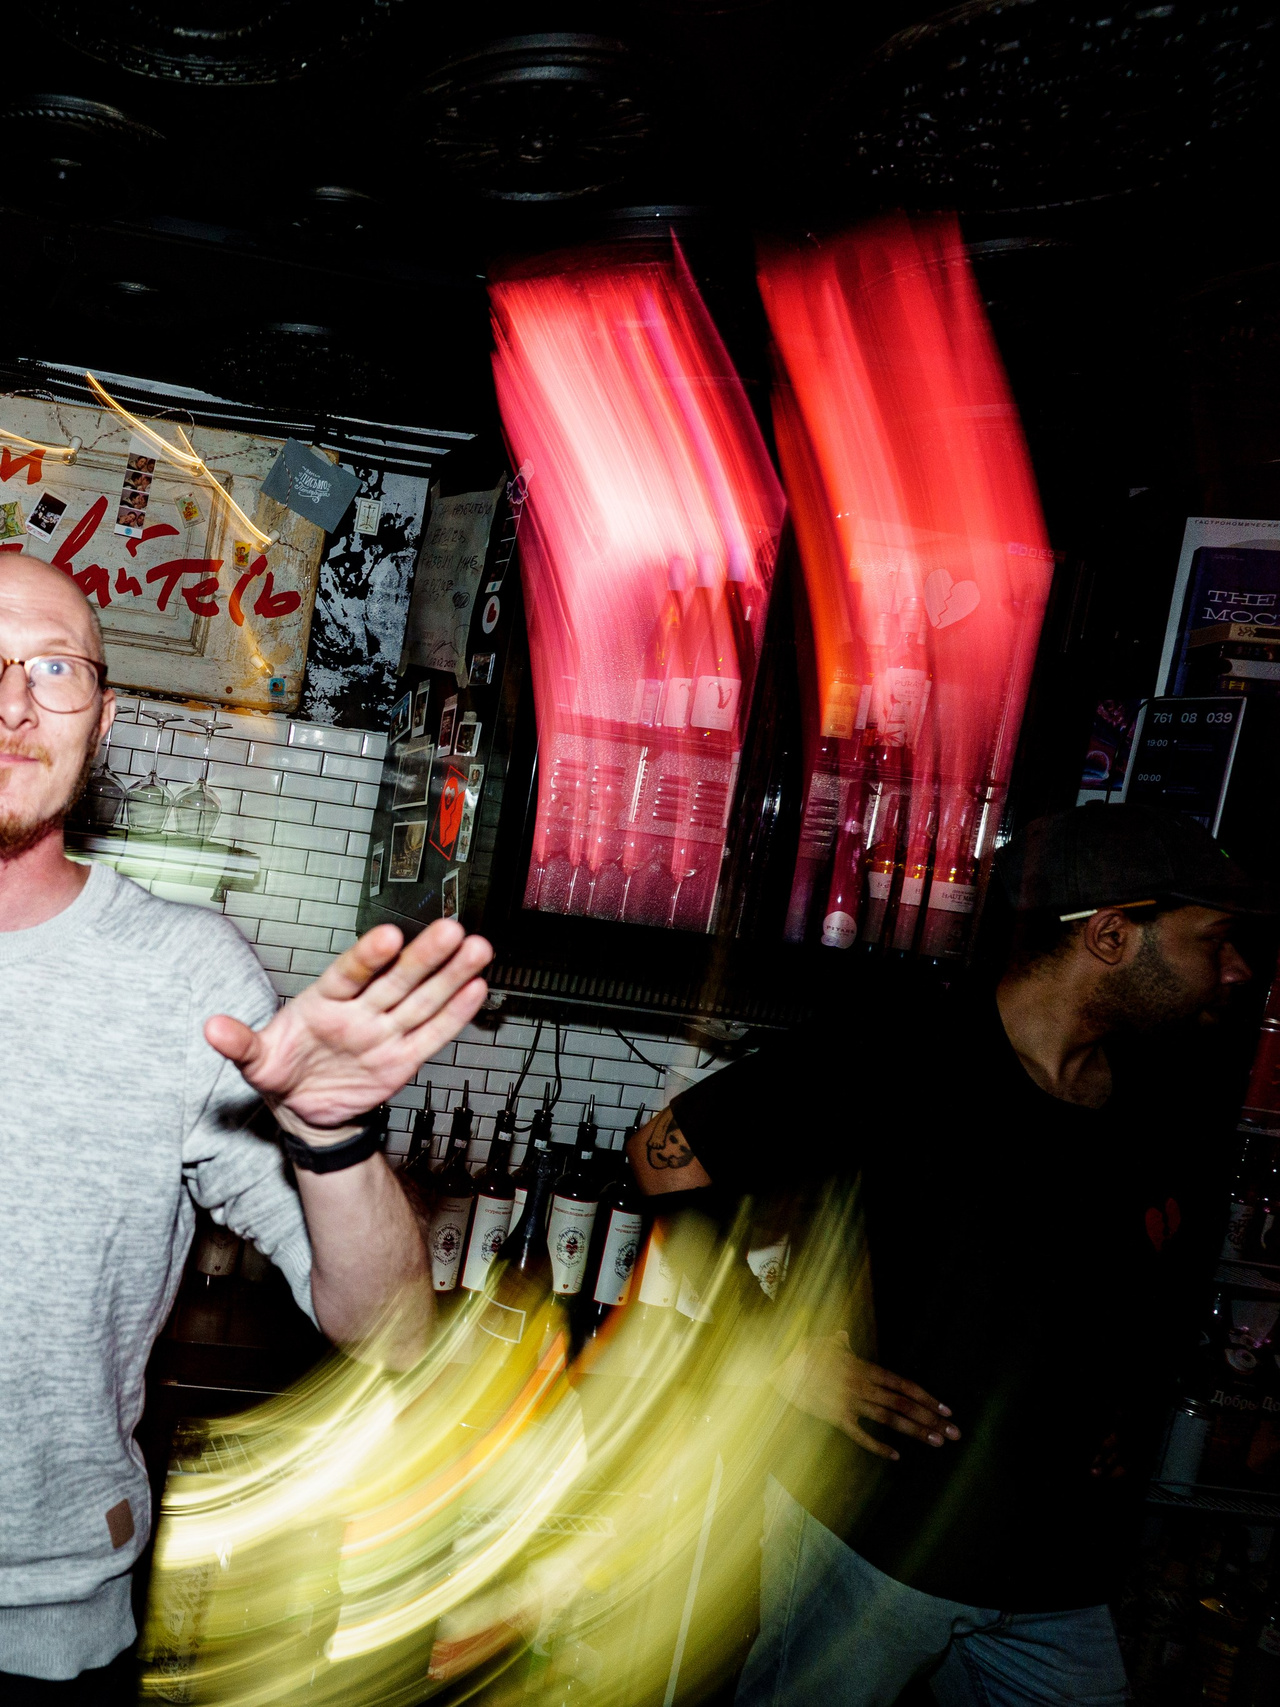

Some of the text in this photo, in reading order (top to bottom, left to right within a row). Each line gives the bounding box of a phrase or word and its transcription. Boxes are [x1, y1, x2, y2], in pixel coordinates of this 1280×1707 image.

[1207, 589, 1277, 607] THE
[1201, 606, 1280, 626] MOC
[1153, 712, 1233, 724] 761 08 039
[1146, 738, 1168, 748] 19:00
[1137, 773, 1162, 782] 00:00
